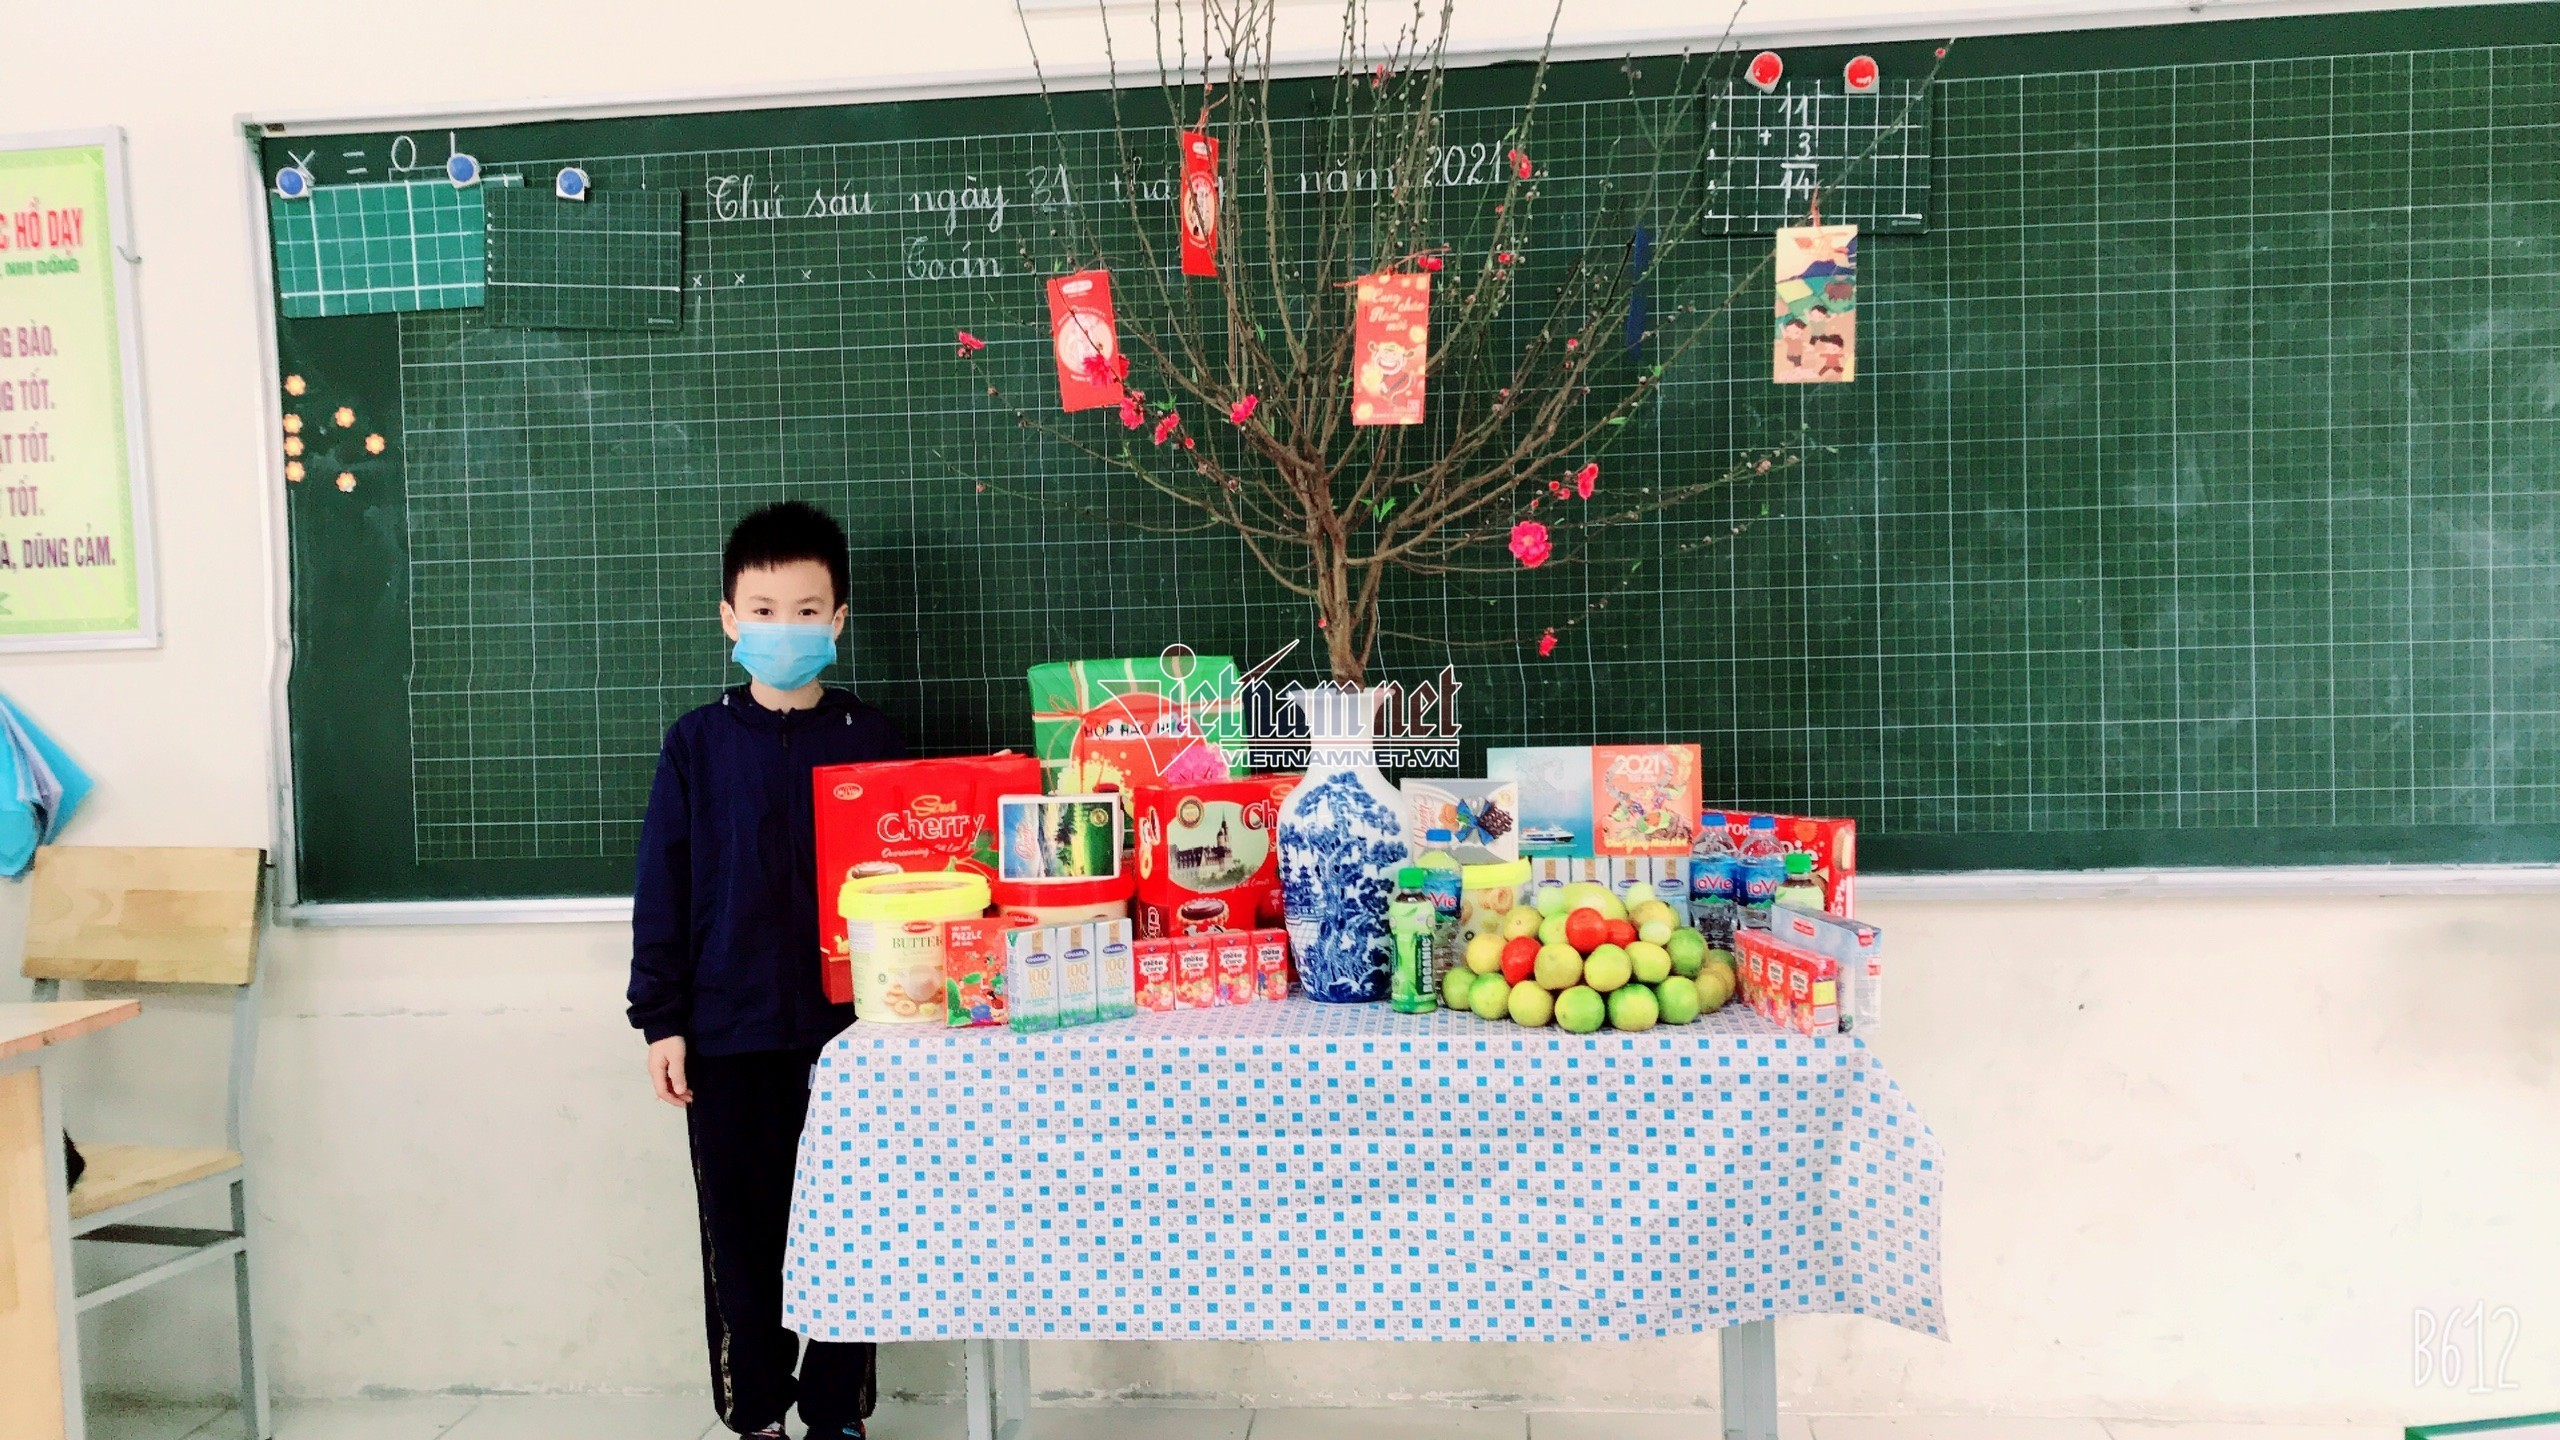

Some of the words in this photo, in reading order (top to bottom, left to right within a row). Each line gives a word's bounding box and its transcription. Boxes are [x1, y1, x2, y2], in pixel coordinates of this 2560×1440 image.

[1778, 95, 1809, 127] 11
[1798, 132, 1812, 160] 3
[705, 174, 785, 221] Thứ
[803, 180, 878, 218] sáu
[909, 175, 1010, 237] ngày
[1423, 139, 1502, 188] 2021
[1779, 170, 1810, 201] 14
[47, 208, 83, 256] DẠY
[903, 236, 1004, 280] Toán
[18, 319, 58, 358] BÀO.
[18, 368, 56, 411] TỐT.
[18, 421, 55, 464] TỐT.
[6, 475, 45, 517] TỐT.
[22, 531, 70, 569] DŨNG
[74, 522, 117, 567] CẢM.
[1614, 754, 1661, 775] 2021
[877, 809, 987, 850] Cherry
